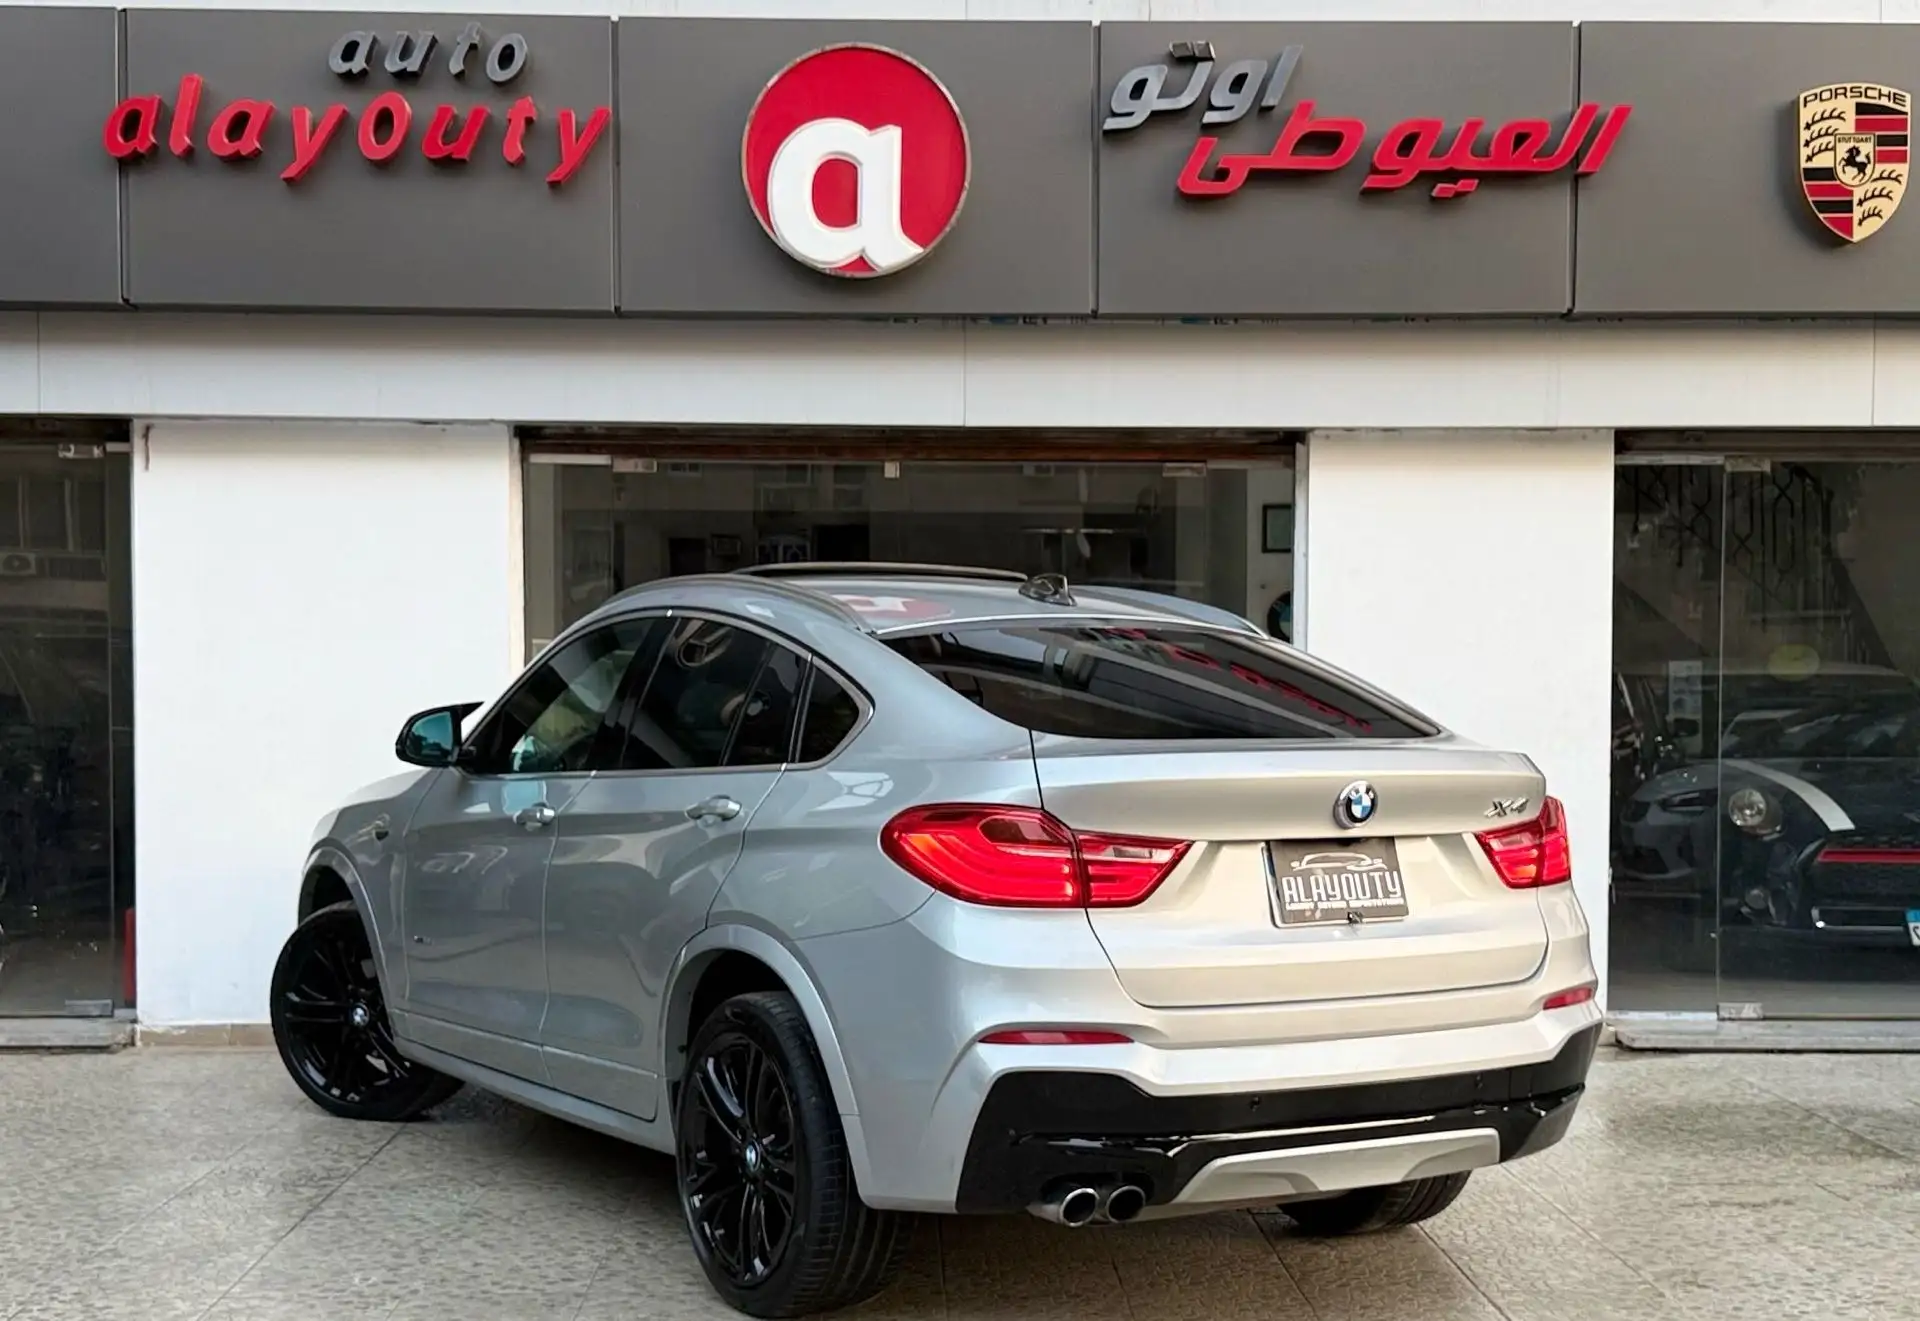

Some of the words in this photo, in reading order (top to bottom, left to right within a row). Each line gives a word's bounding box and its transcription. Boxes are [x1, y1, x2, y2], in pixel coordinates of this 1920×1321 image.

[329, 22, 529, 83] auto
[1102, 40, 1303, 134] اوتو
[1804, 86, 1907, 107] PORSCHE
[767, 117, 924, 272] a
[1281, 871, 1402, 902] ALAYOUTY
